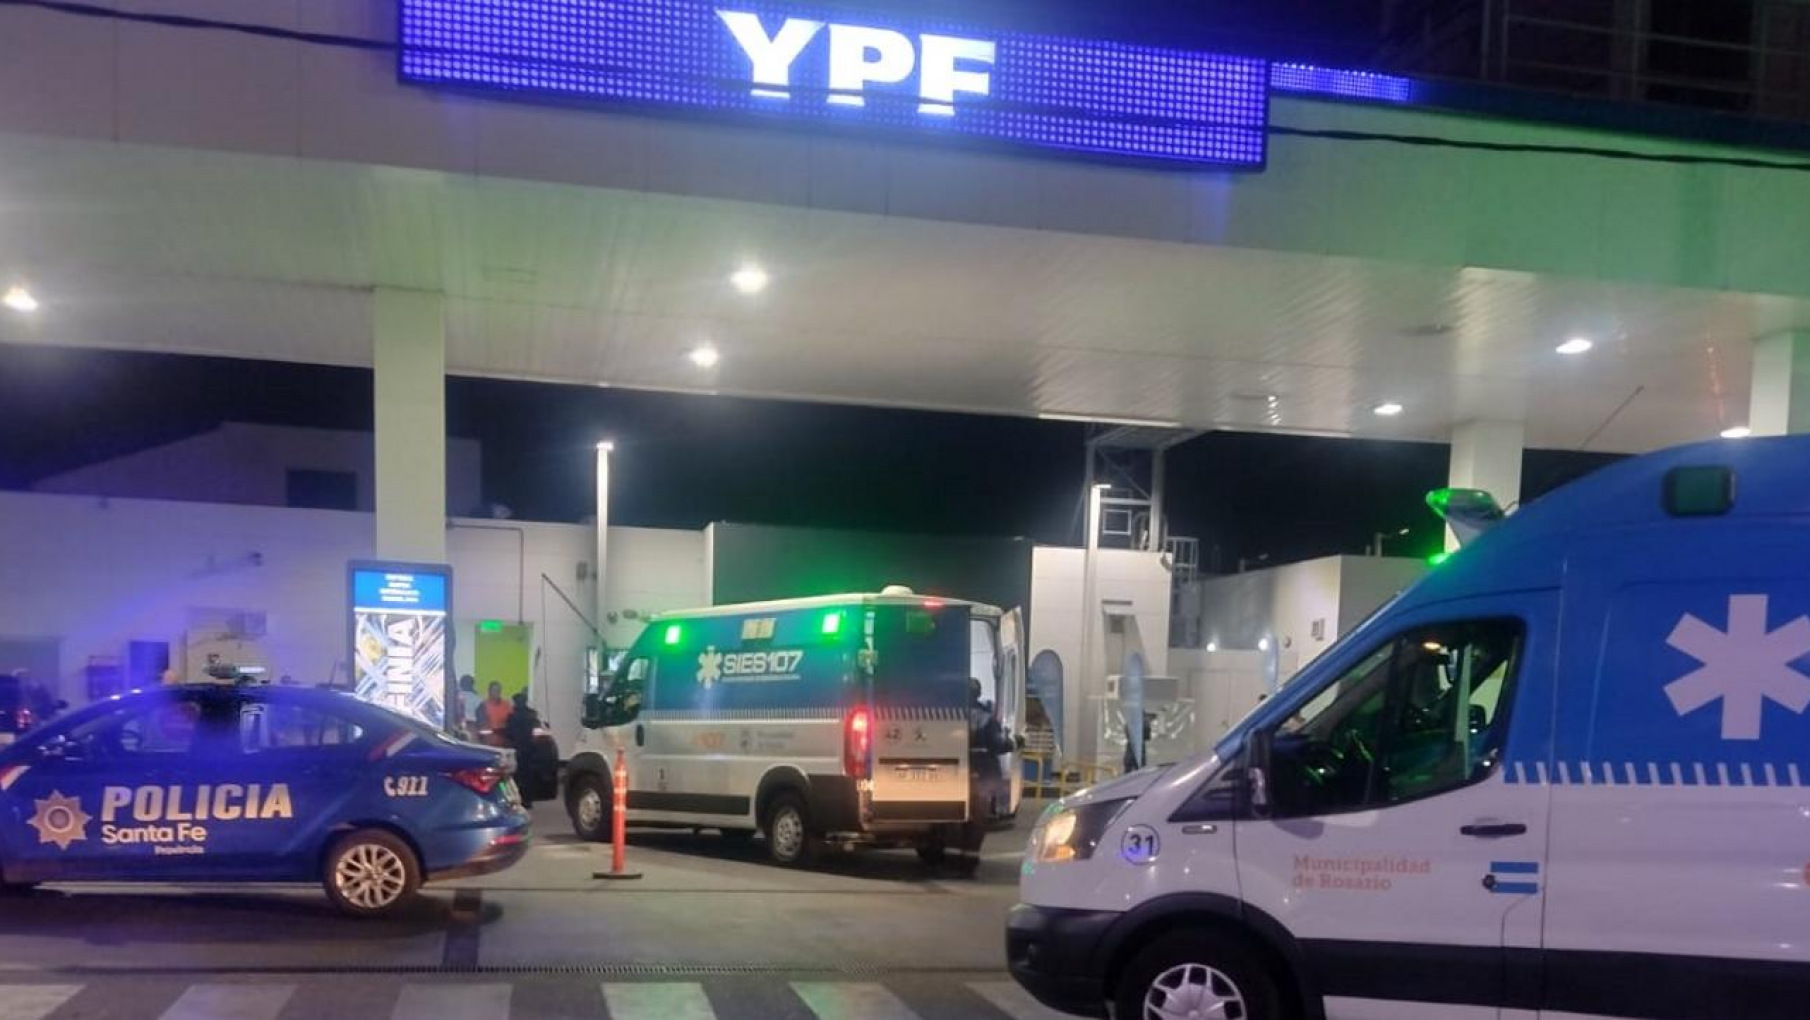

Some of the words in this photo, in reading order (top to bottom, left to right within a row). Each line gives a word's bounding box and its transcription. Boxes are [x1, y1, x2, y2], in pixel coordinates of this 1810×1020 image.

[714, 8, 997, 116] YPF
[100, 782, 292, 822] POLICIA
[101, 824, 173, 844] Santa
[177, 822, 207, 842] Fe
[1128, 833, 1153, 856] 31
[1293, 855, 1431, 875] Municipalidad
[1292, 873, 1314, 888] de
[1319, 874, 1392, 890] Rosario
